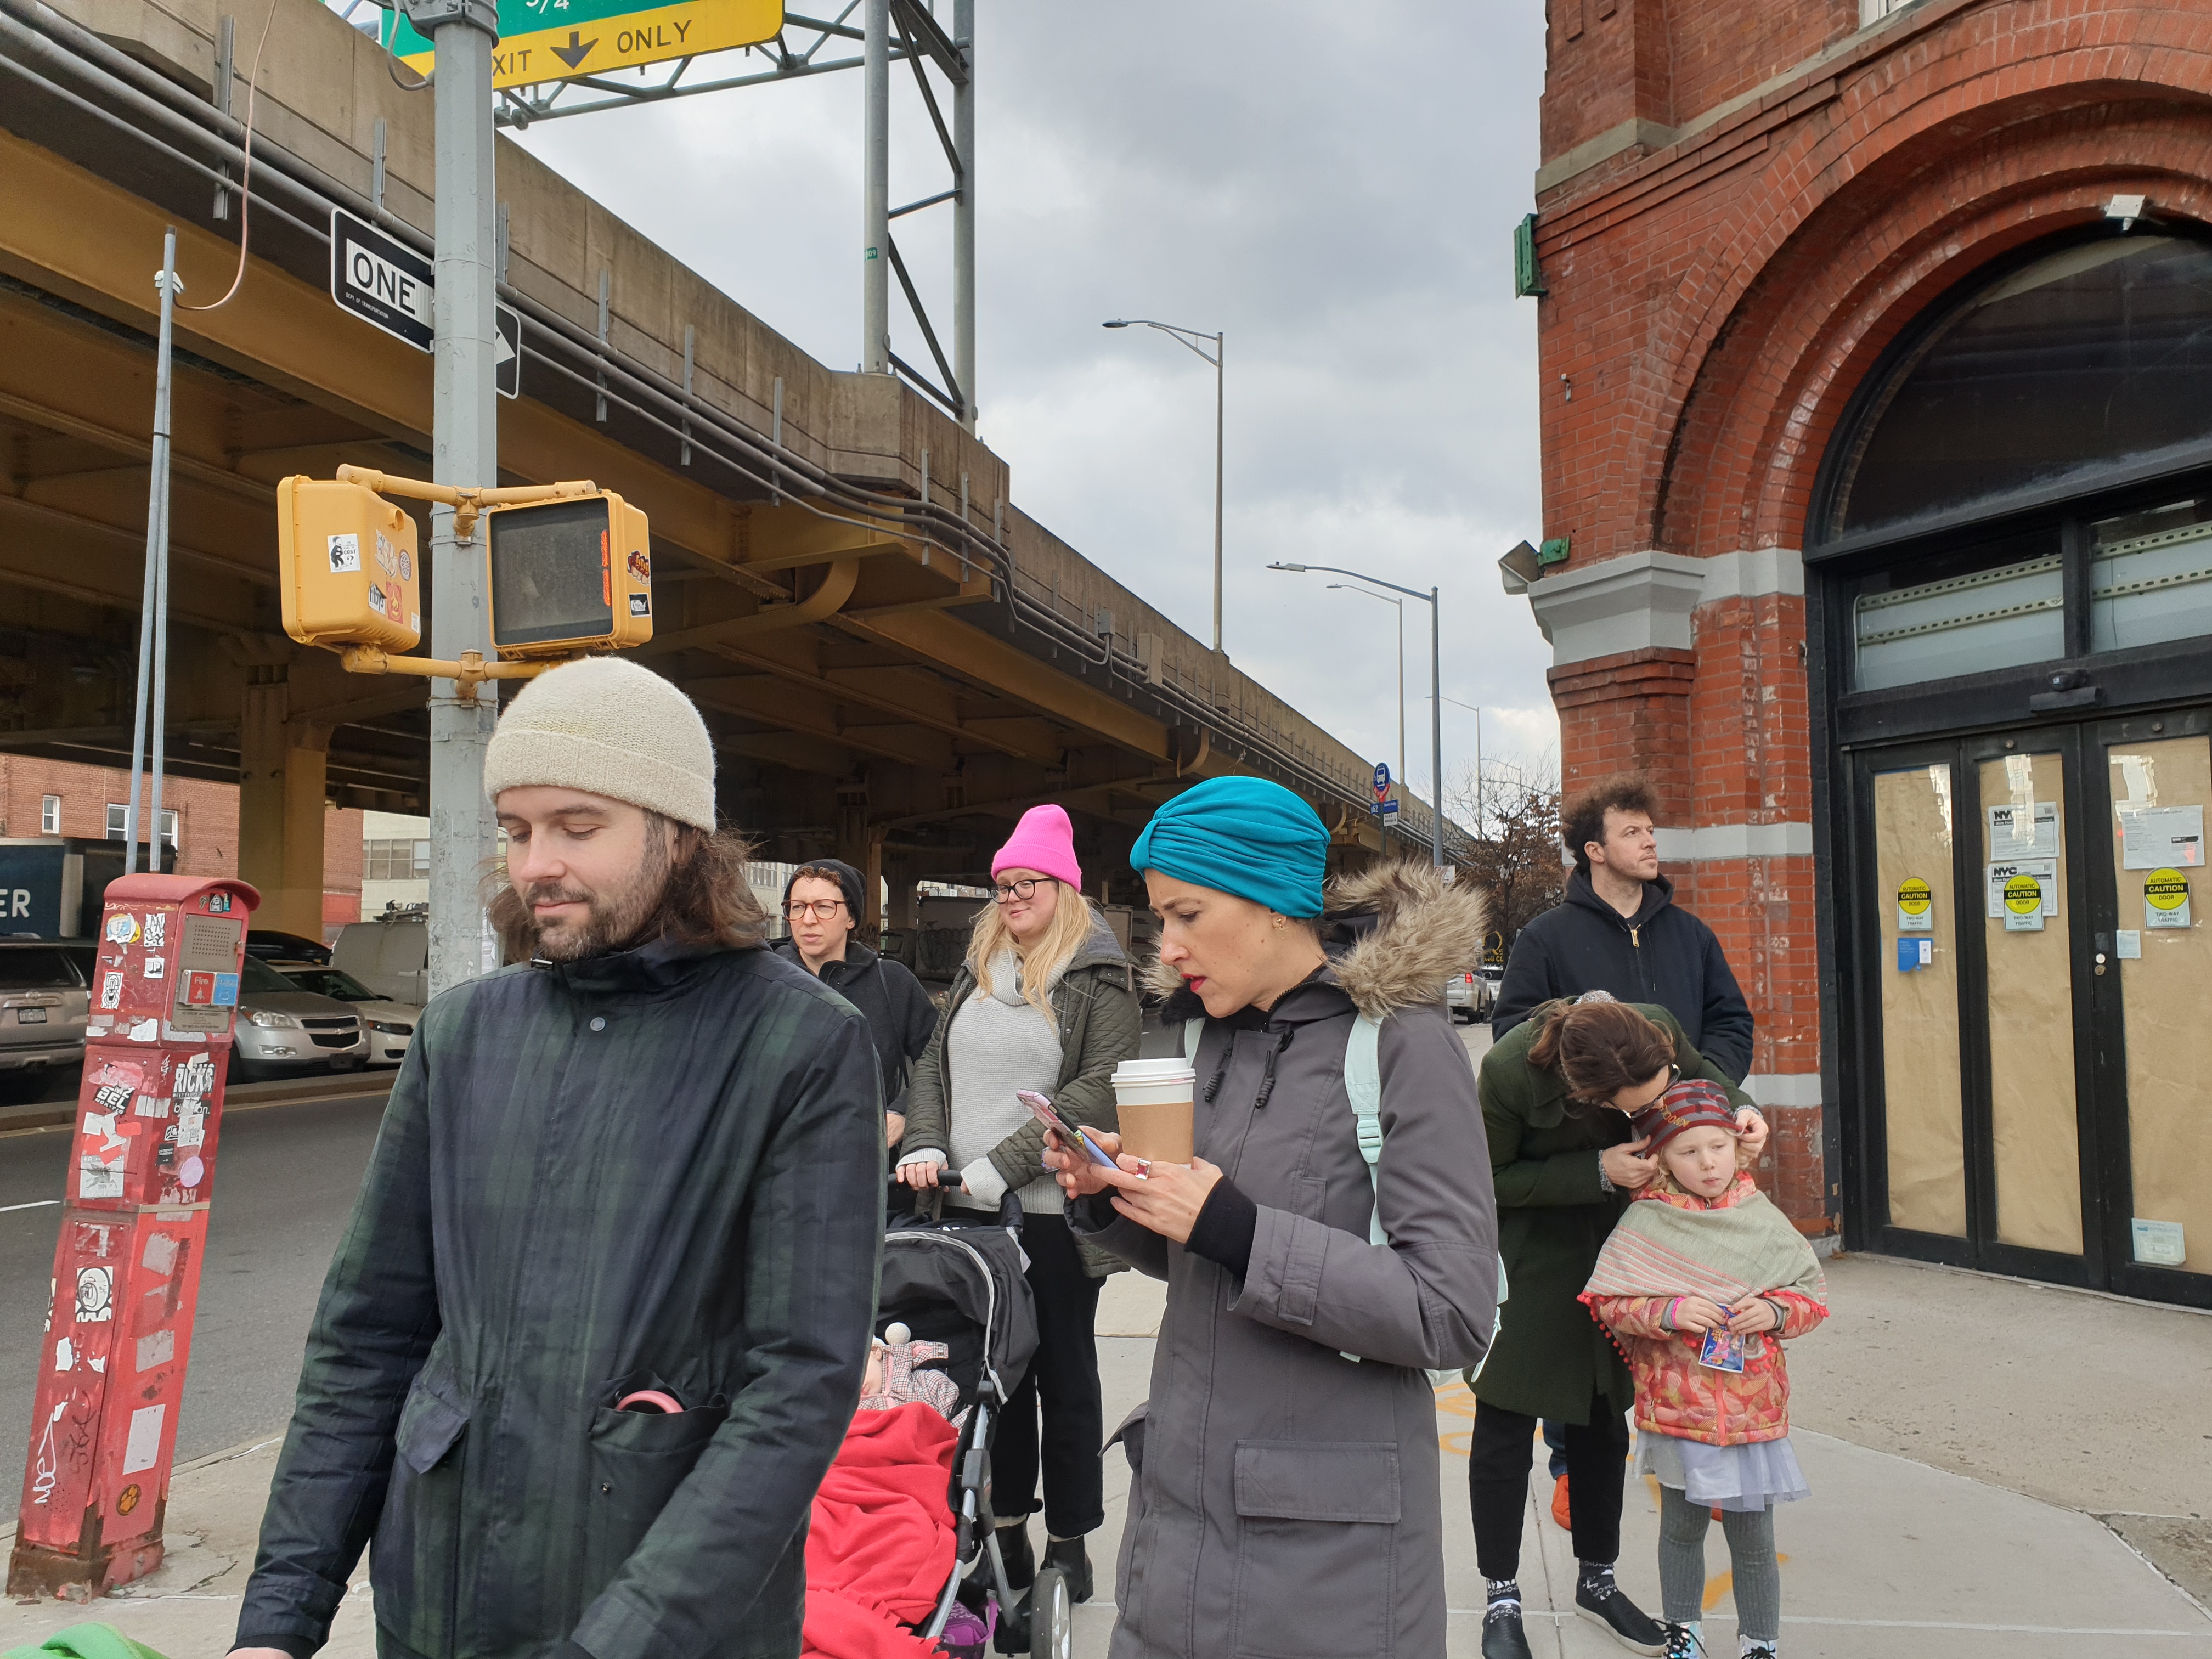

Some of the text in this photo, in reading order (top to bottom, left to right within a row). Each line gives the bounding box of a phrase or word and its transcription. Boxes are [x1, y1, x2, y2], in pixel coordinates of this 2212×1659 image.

[493, 19, 692, 76] XIT ONLY
[353, 252, 415, 315] ONE
[1994, 866, 2017, 876] NYC
[2148, 884, 2183, 893] CAUTION
[195, 976, 209, 985] Fire
